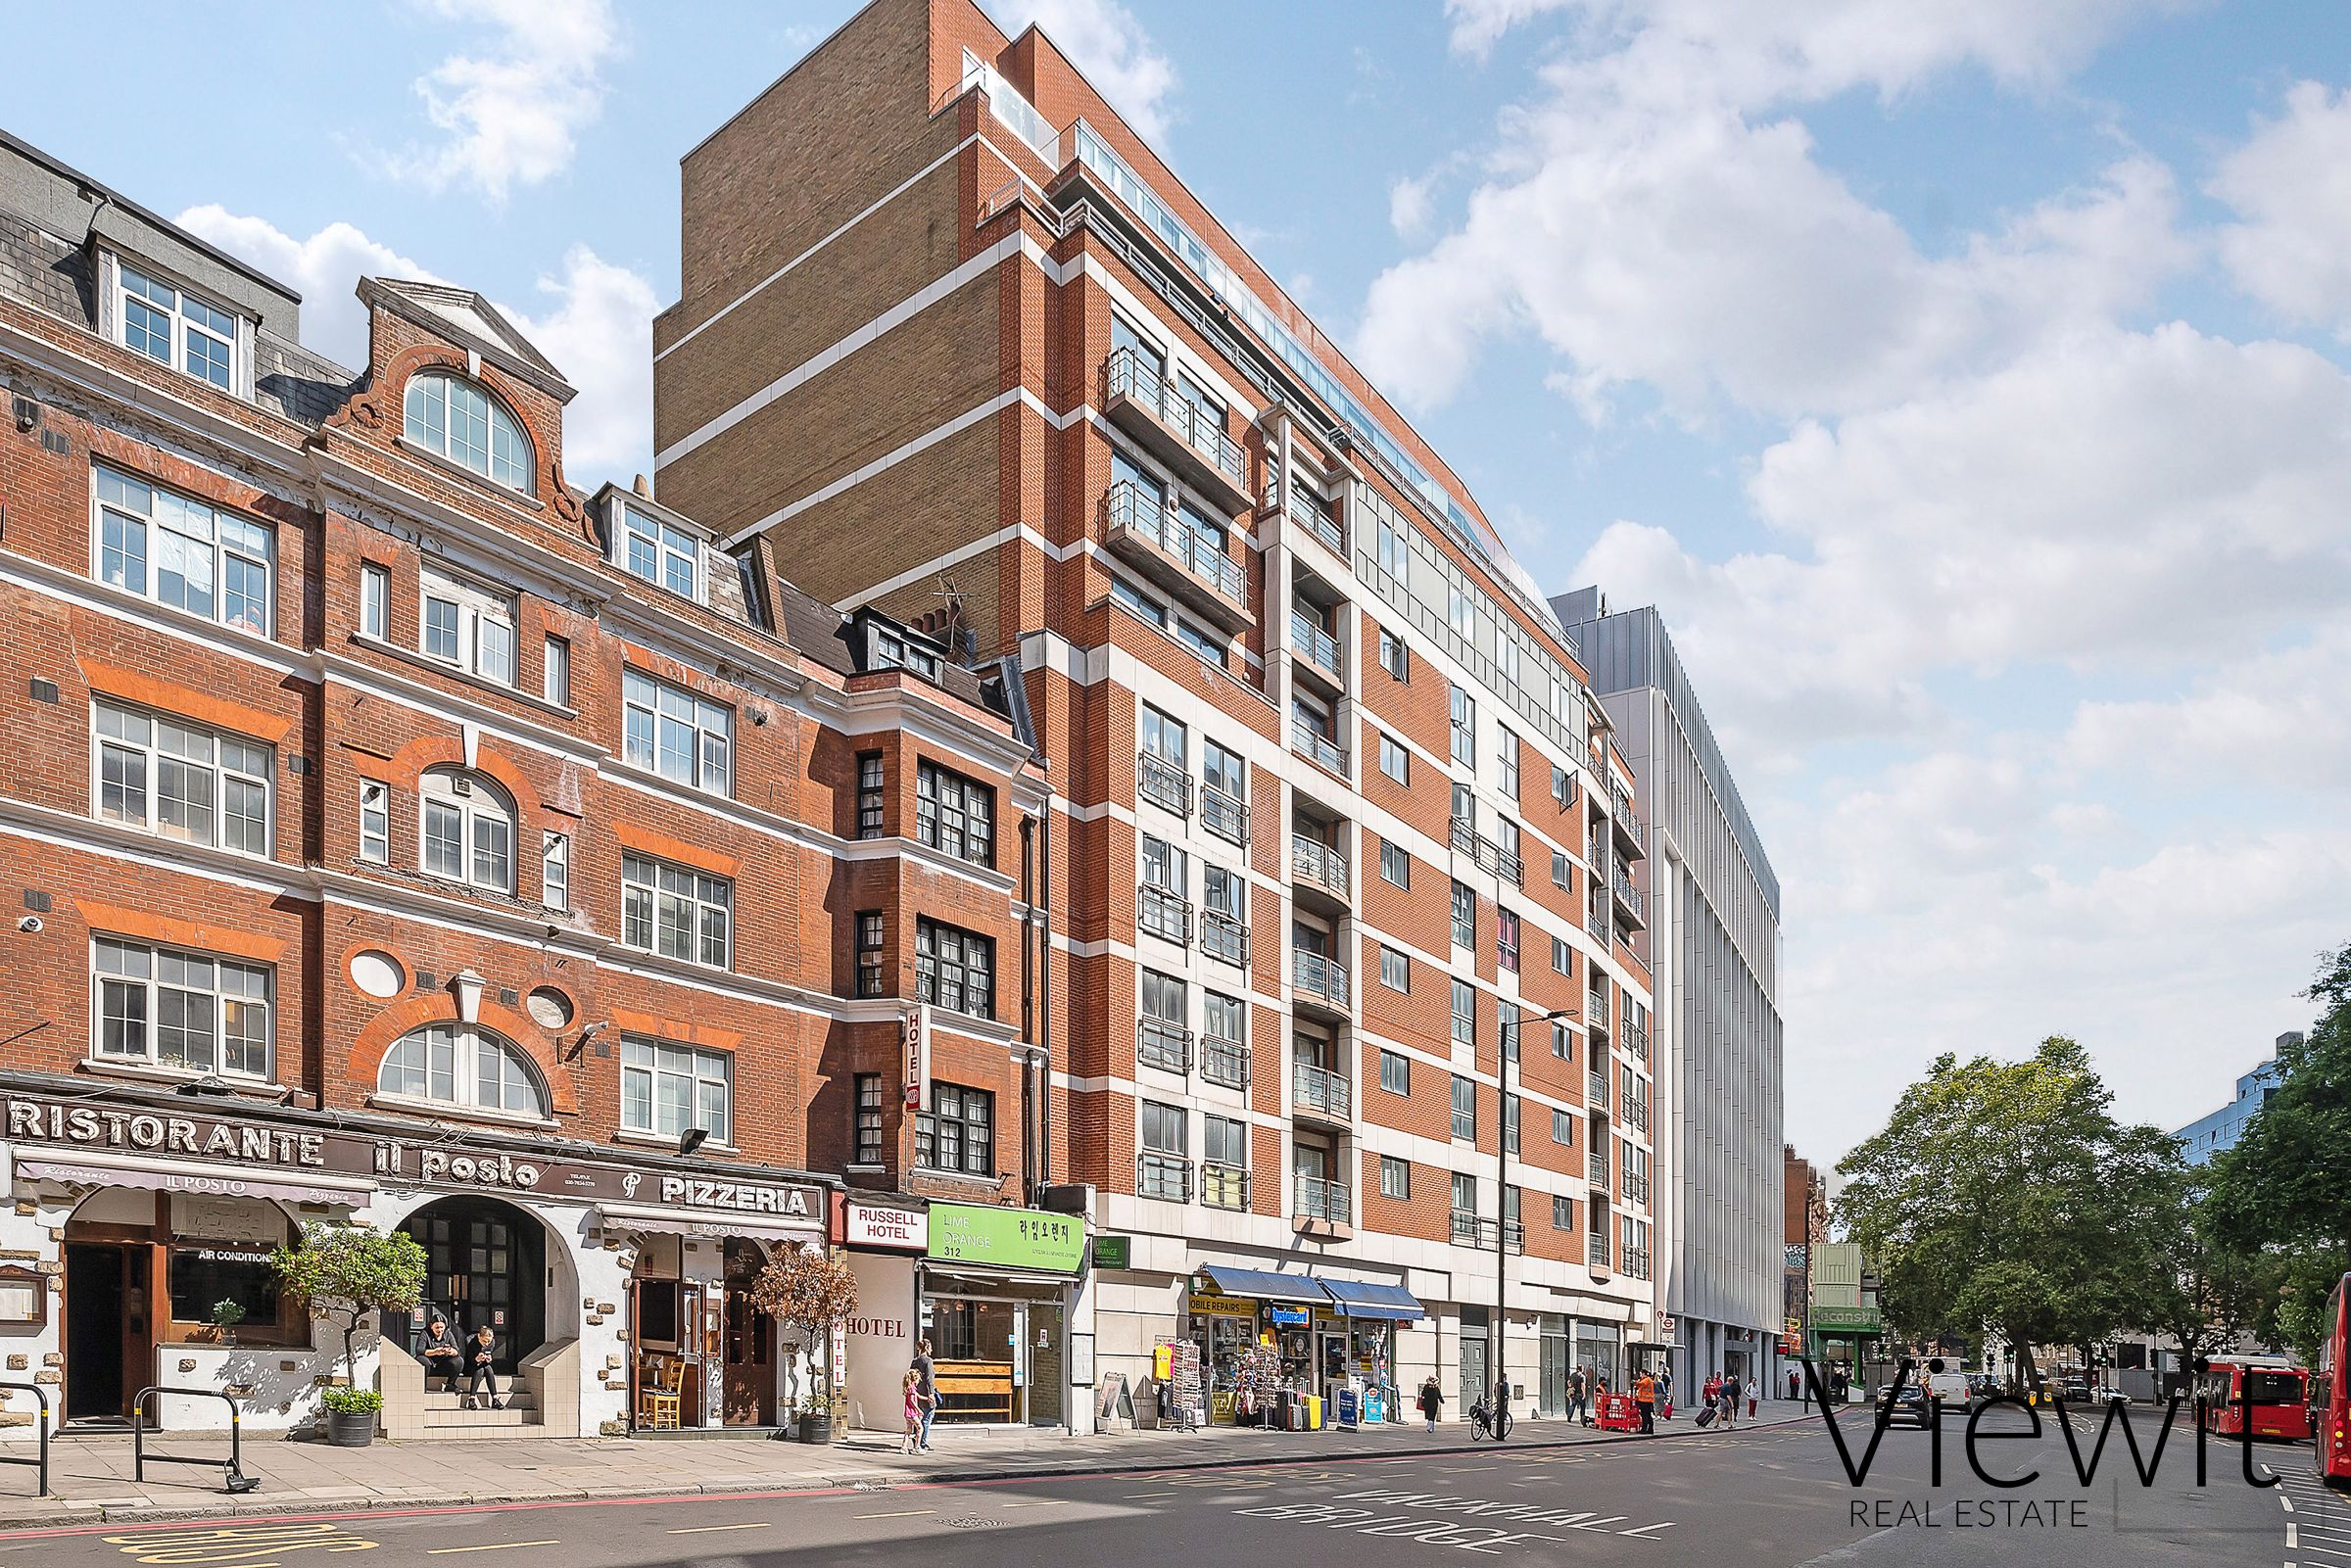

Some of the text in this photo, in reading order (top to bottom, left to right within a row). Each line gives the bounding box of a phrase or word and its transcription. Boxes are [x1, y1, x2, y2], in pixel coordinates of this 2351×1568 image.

[910, 1014, 919, 1084] HOTEL
[9, 1100, 325, 1166] RISTORANTE
[375, 1141, 402, 1173] il
[43, 1165, 111, 1180] Ristorante
[166, 1175, 246, 1193] IL POSTO
[309, 1189, 350, 1201] Pizzeria
[662, 1176, 808, 1215] PIZZERIA
[858, 1209, 918, 1226] RUSSELL
[943, 1213, 970, 1228] LIME
[692, 1222, 743, 1235] IL POSTO
[867, 1224, 910, 1240] HOTEL
[1020, 1220, 1069, 1245] 라임오렌지
[942, 1231, 991, 1248] ORANGE
[199, 1250, 216, 1260] AIR
[943, 1246, 961, 1257] 312
[1094, 1247, 1118, 1256] ORANGE
[1212, 1302, 1240, 1312] REPAIRS
[1272, 1307, 1309, 1325] Oystercard
[846, 1317, 906, 1338] HOTEL
[1332, 1489, 1676, 1541] VAUXHALL
[1231, 1503, 1567, 1555] BRIDGE
